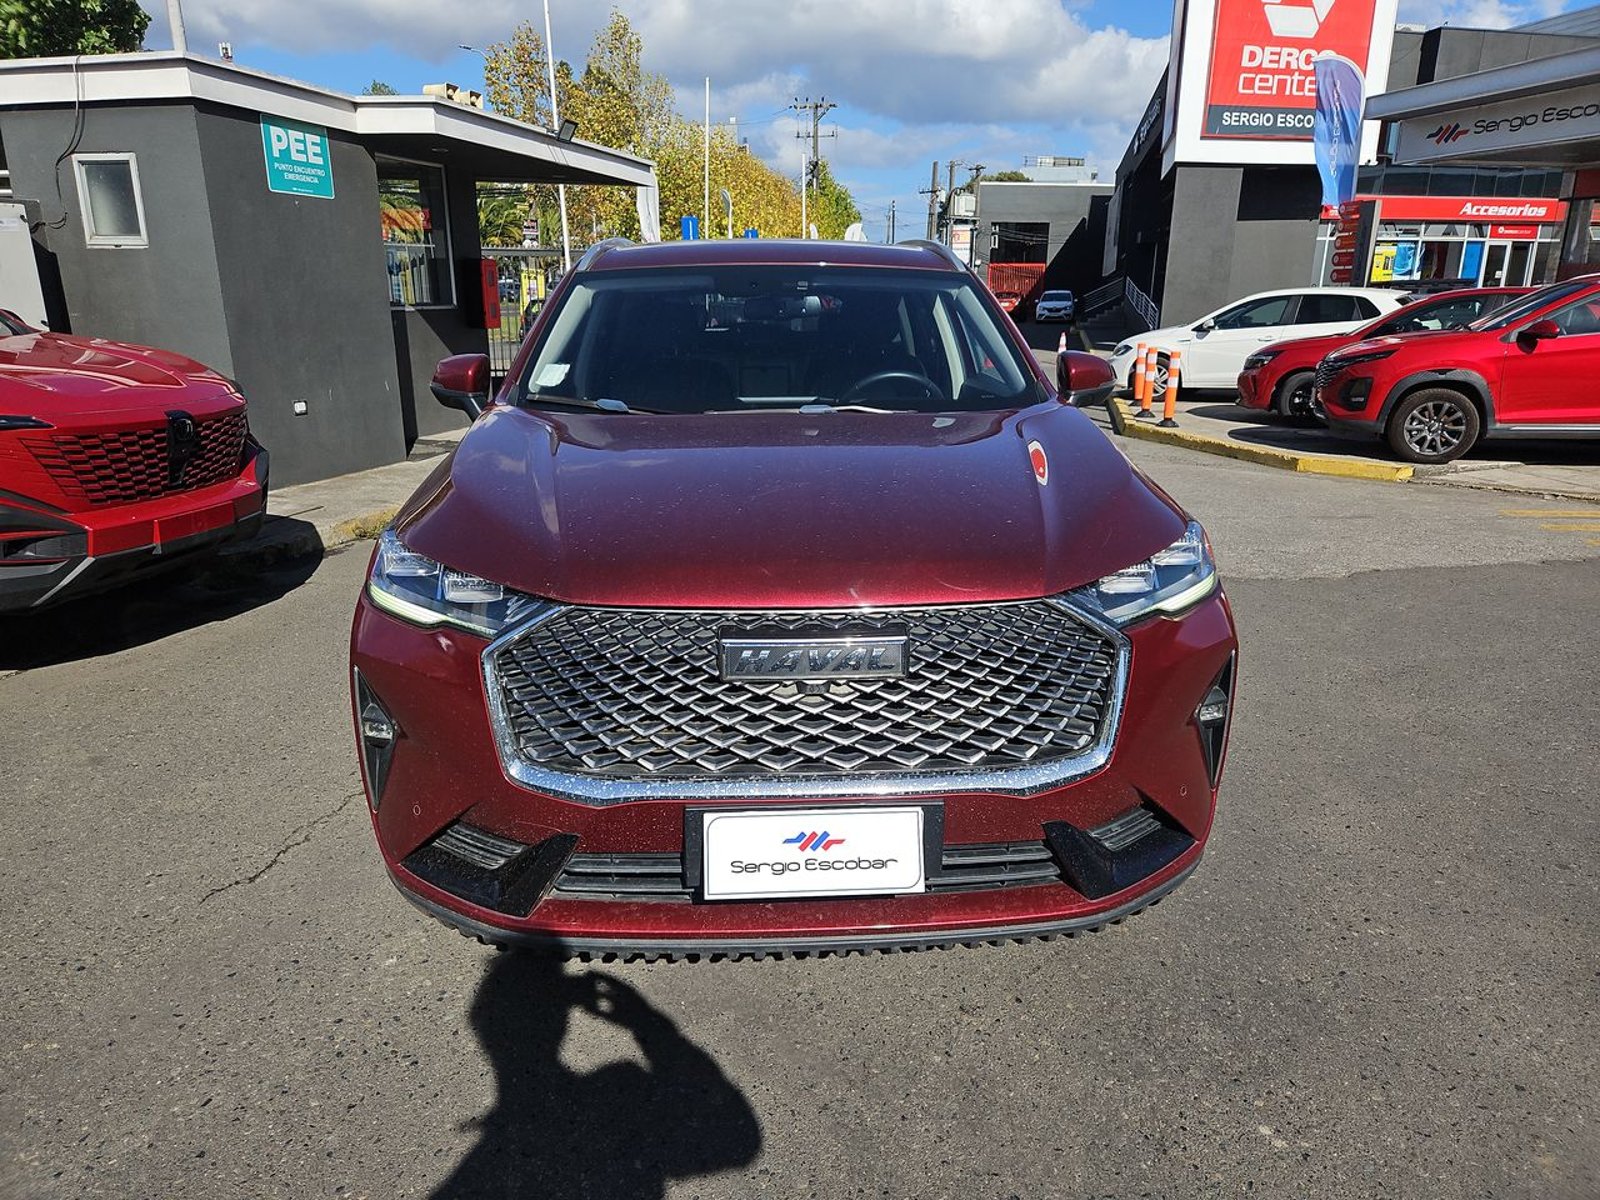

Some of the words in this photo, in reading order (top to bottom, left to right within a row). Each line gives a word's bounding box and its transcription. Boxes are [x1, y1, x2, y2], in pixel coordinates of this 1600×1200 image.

[1241, 45, 1338, 70] DERC
[1238, 71, 1317, 97] cente
[1222, 112, 1274, 127] SERGIO
[1276, 113, 1316, 129] ESCO
[1474, 113, 1539, 135] Sergio
[1541, 103, 1600, 123] Esco
[269, 125, 324, 165] PEE
[274, 162, 293, 172] PUNTO
[293, 165, 325, 177] ENCUENTRO
[284, 172, 319, 184] EMERGENCIA
[1460, 202, 1548, 217] Accesorios
[735, 648, 896, 673] HAVAL
[730, 860, 801, 875] Sergio
[804, 856, 898, 871] Escobar
